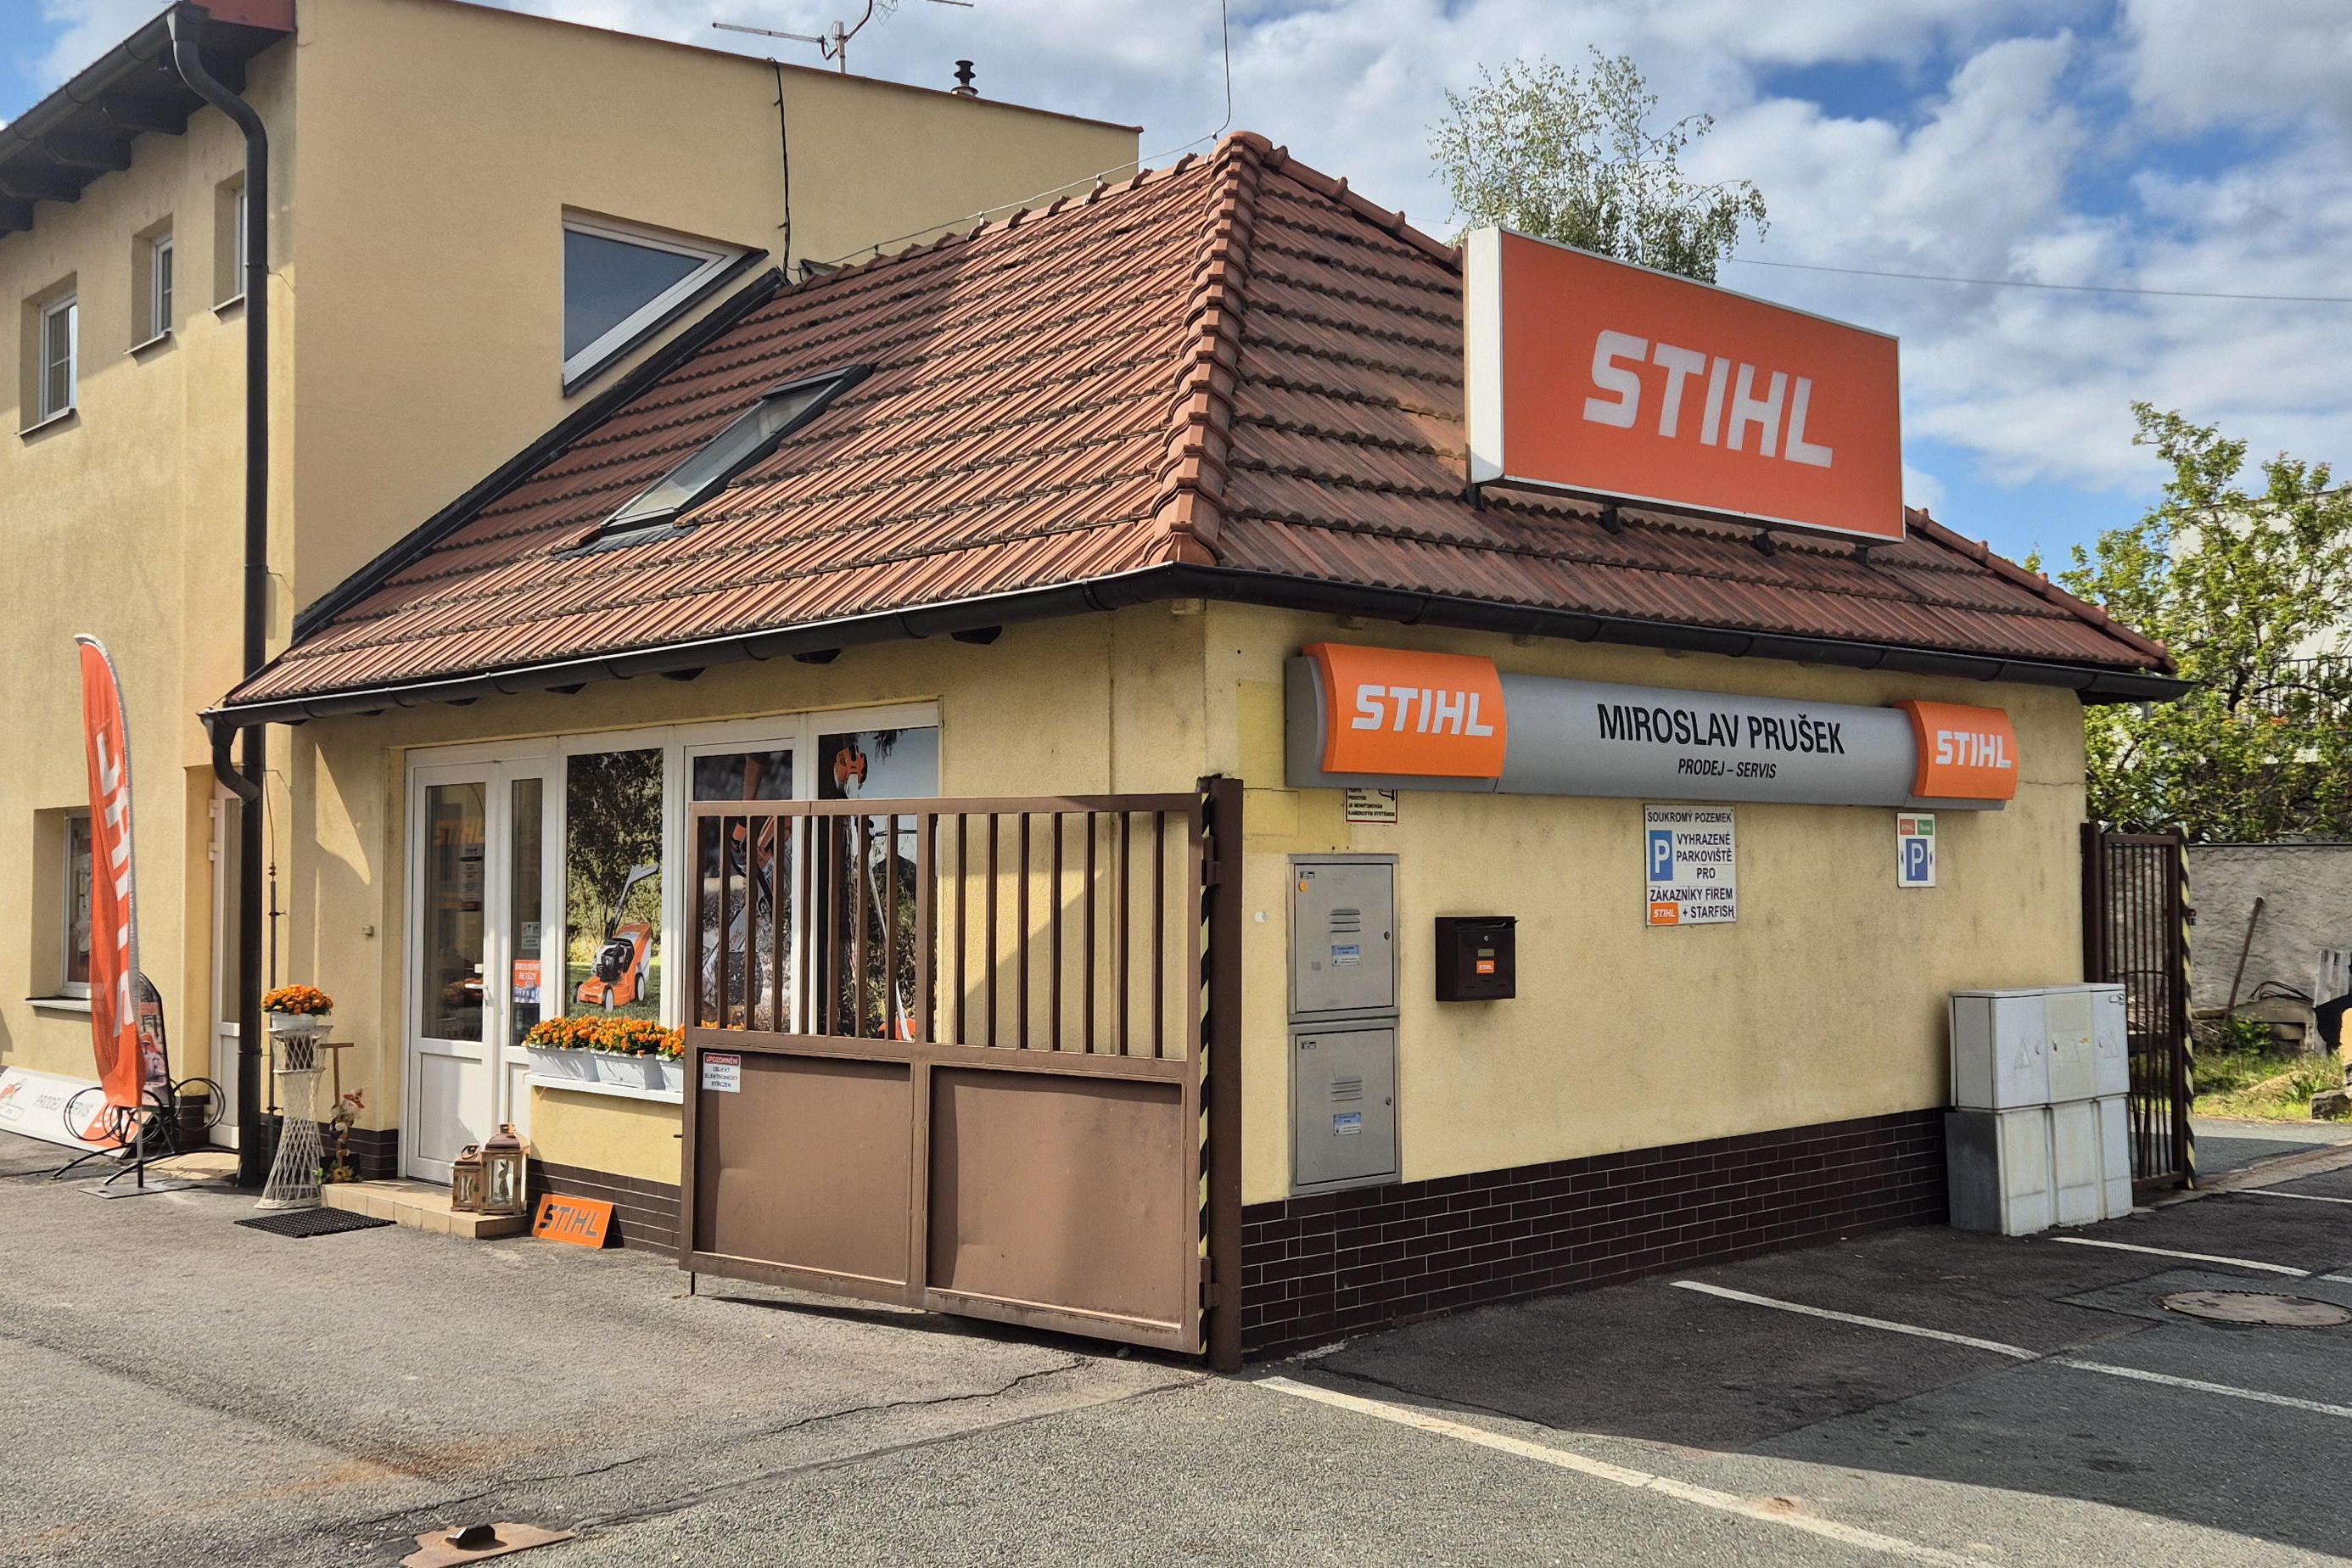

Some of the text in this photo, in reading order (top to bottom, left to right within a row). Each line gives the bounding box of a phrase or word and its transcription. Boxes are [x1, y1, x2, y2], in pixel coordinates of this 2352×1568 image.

[1582, 329, 1833, 468] STIHL
[1351, 684, 1494, 736] STIHL
[1597, 704, 1845, 754] MIROSLAV PRUŠEK
[1935, 730, 2012, 768] STIHL
[1677, 759, 1725, 777] PRODEJ
[1736, 762, 1777, 779] SERVIS
[1648, 809, 1732, 823] SOUKROMÝ POZEMEK
[1677, 831, 1731, 845] VYHRAZENÉ
[1655, 839, 1671, 874] P
[1677, 848, 1733, 862] PARKOVIŠTĚ
[1911, 843, 1924, 876] P
[1696, 867, 1716, 878] PRO
[1649, 886, 1733, 902] ZÁKAZNÍKY FIREM
[1654, 909, 1677, 918] STIHL
[1690, 905, 1734, 918] STARFISH
[539, 1204, 598, 1236] STIHL
